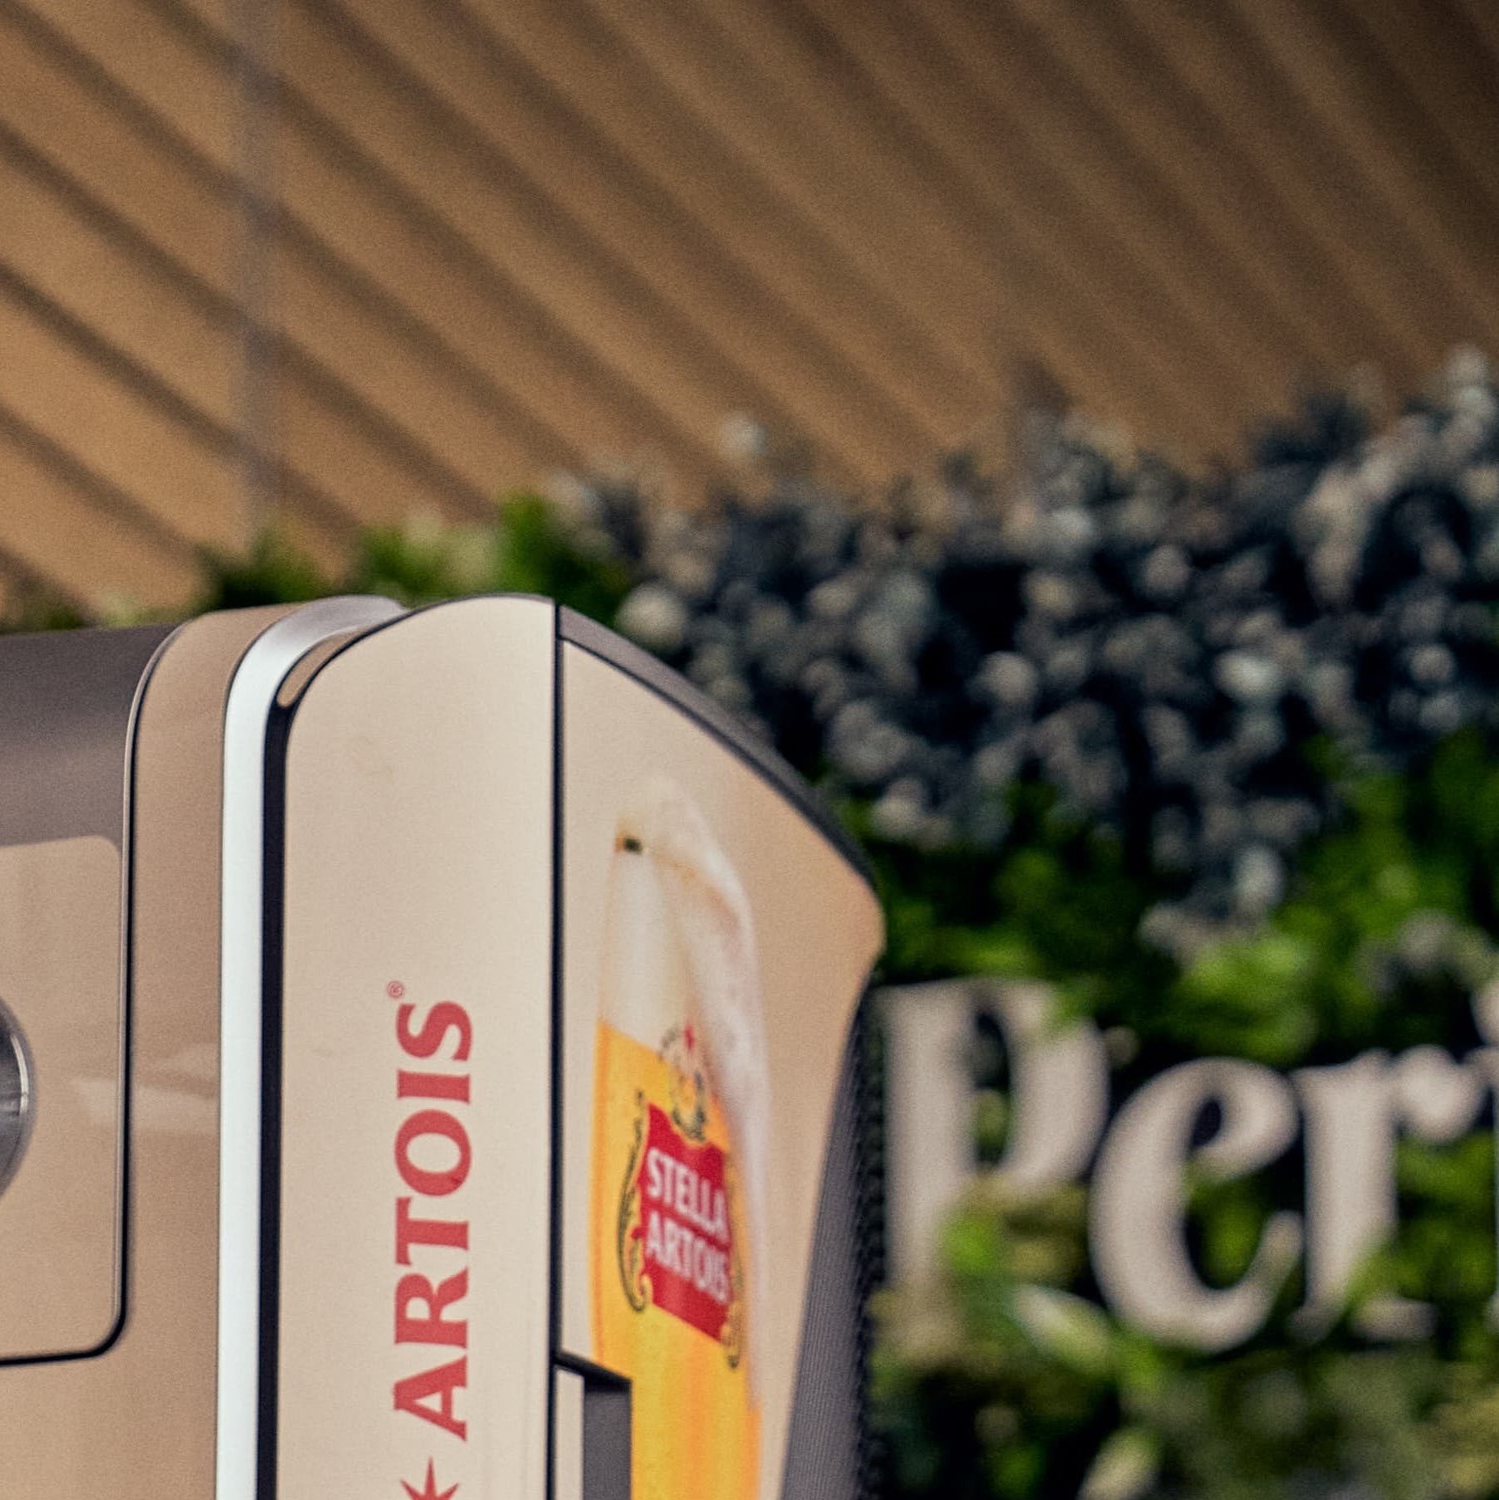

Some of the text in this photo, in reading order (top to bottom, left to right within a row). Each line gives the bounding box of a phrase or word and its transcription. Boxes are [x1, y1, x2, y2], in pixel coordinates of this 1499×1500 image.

[647, 1147, 729, 1244] STELLA
[872, 976, 1499, 1358] Per
[646, 1210, 730, 1304] ARTOIS
